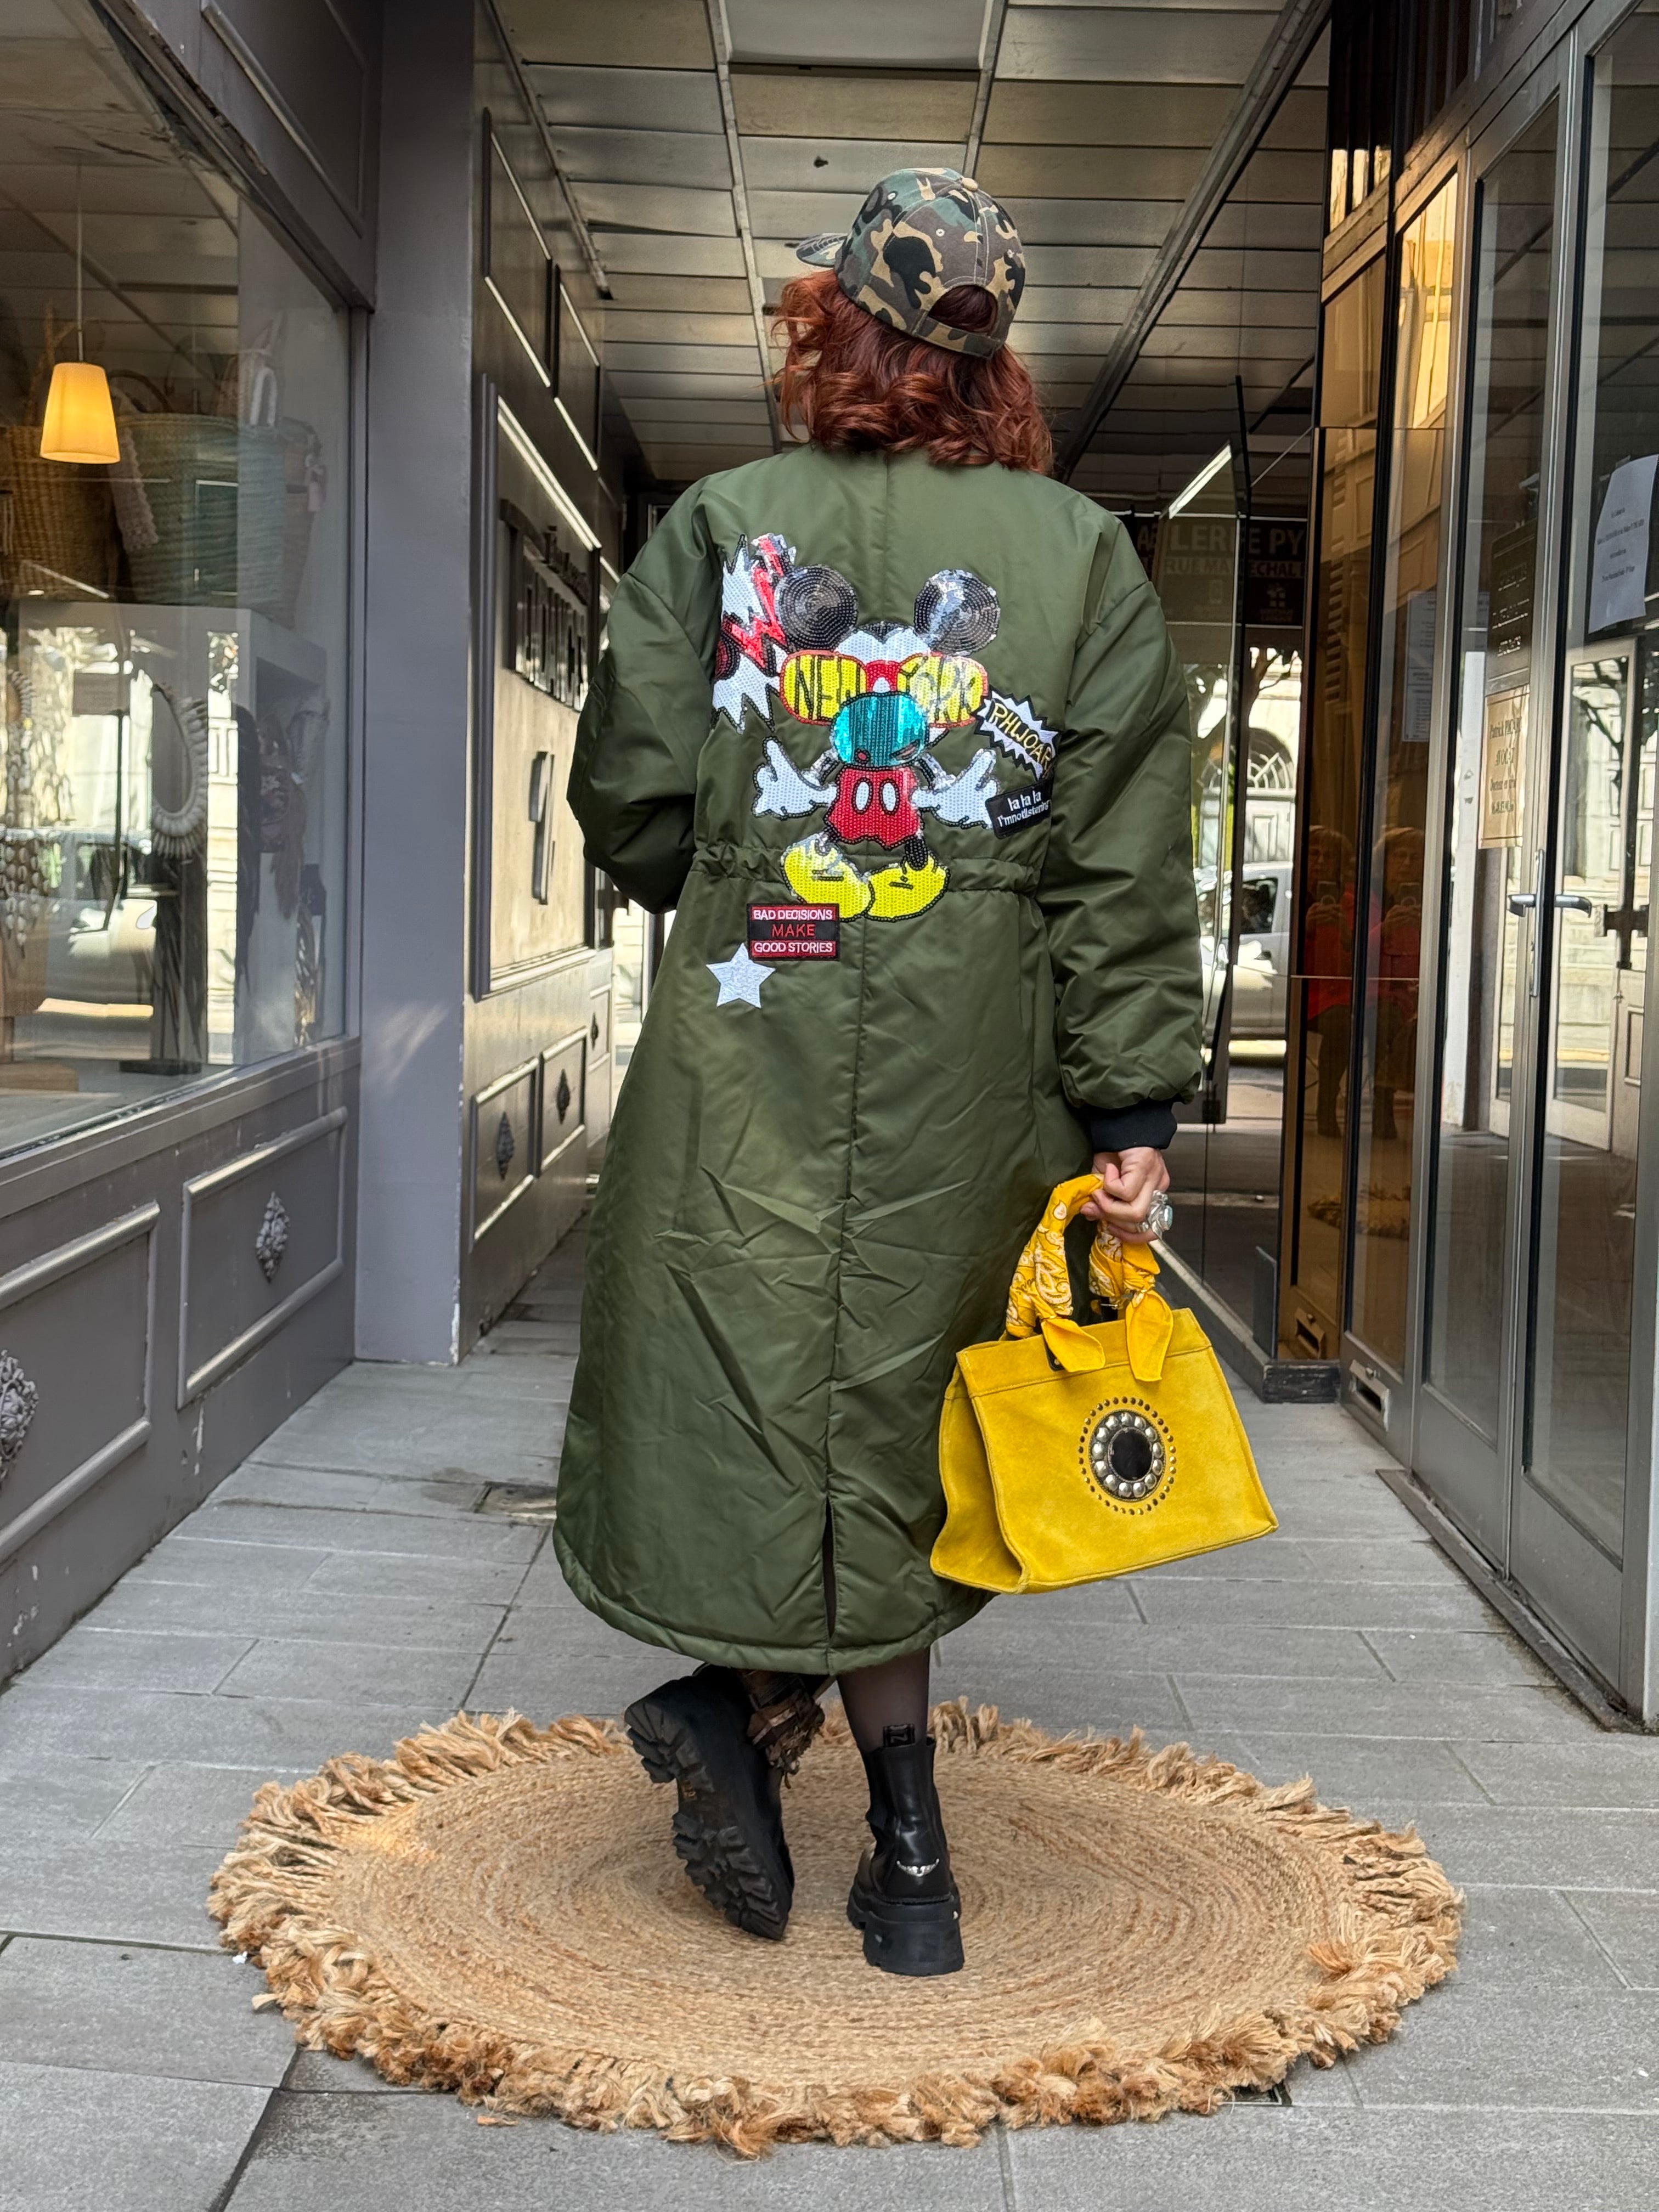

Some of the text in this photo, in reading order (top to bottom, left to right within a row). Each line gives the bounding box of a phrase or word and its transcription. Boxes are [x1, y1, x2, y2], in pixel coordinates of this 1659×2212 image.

[1007, 790, 1042, 812] la la la
[753, 909, 833, 921] BAD DECISIONS
[771, 923, 816, 938] MAKE
[754, 942, 833, 953] GOOD STORIES
